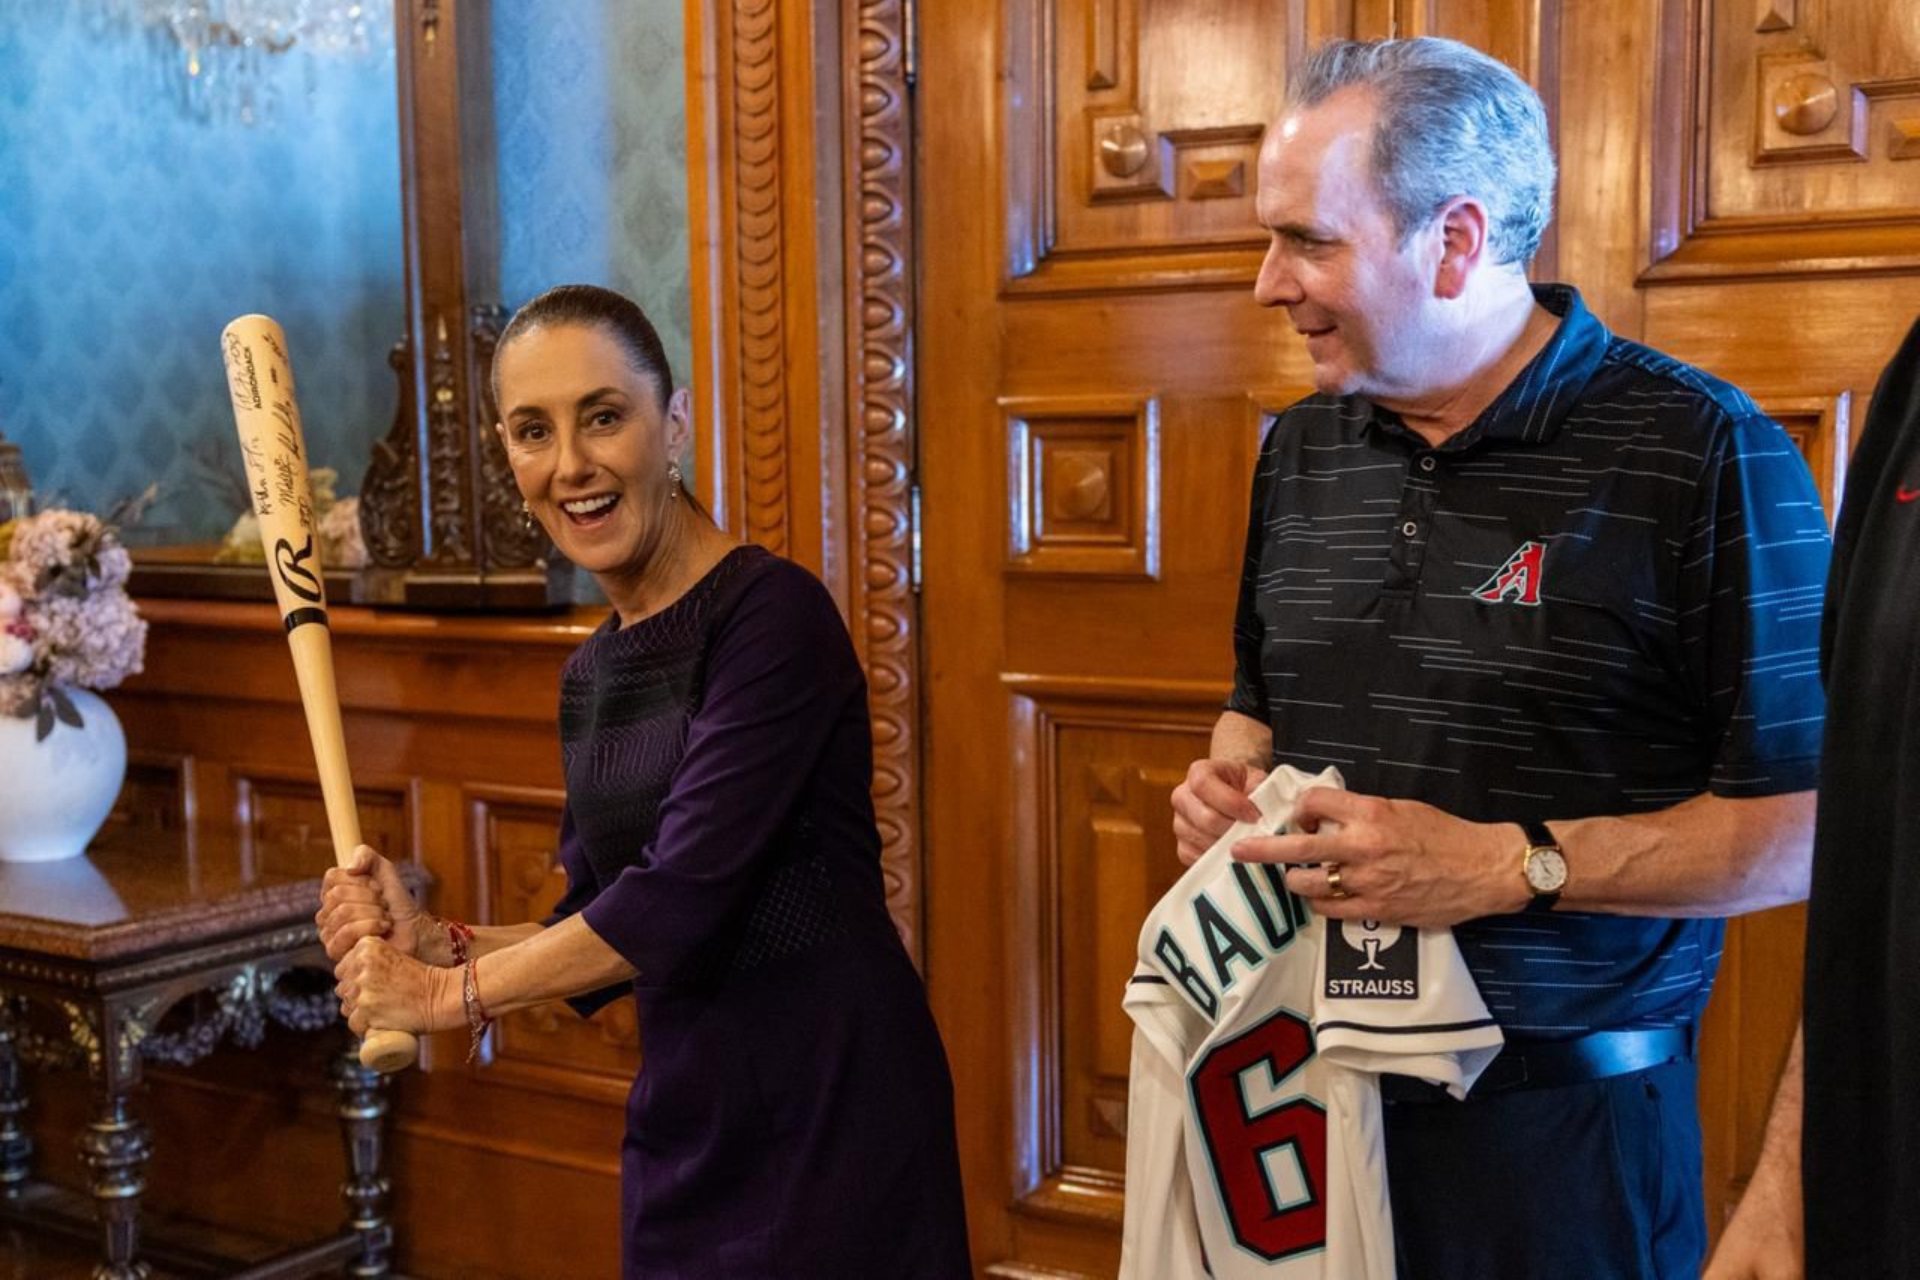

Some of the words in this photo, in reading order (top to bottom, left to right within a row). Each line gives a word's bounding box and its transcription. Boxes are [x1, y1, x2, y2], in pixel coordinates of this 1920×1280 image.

[244, 346, 262, 409] ADIRONDACK
[275, 532, 321, 602] R
[1470, 541, 1547, 605] A
[1328, 979, 1415, 995] STRAUSS
[1187, 1007, 1327, 1264] 6
